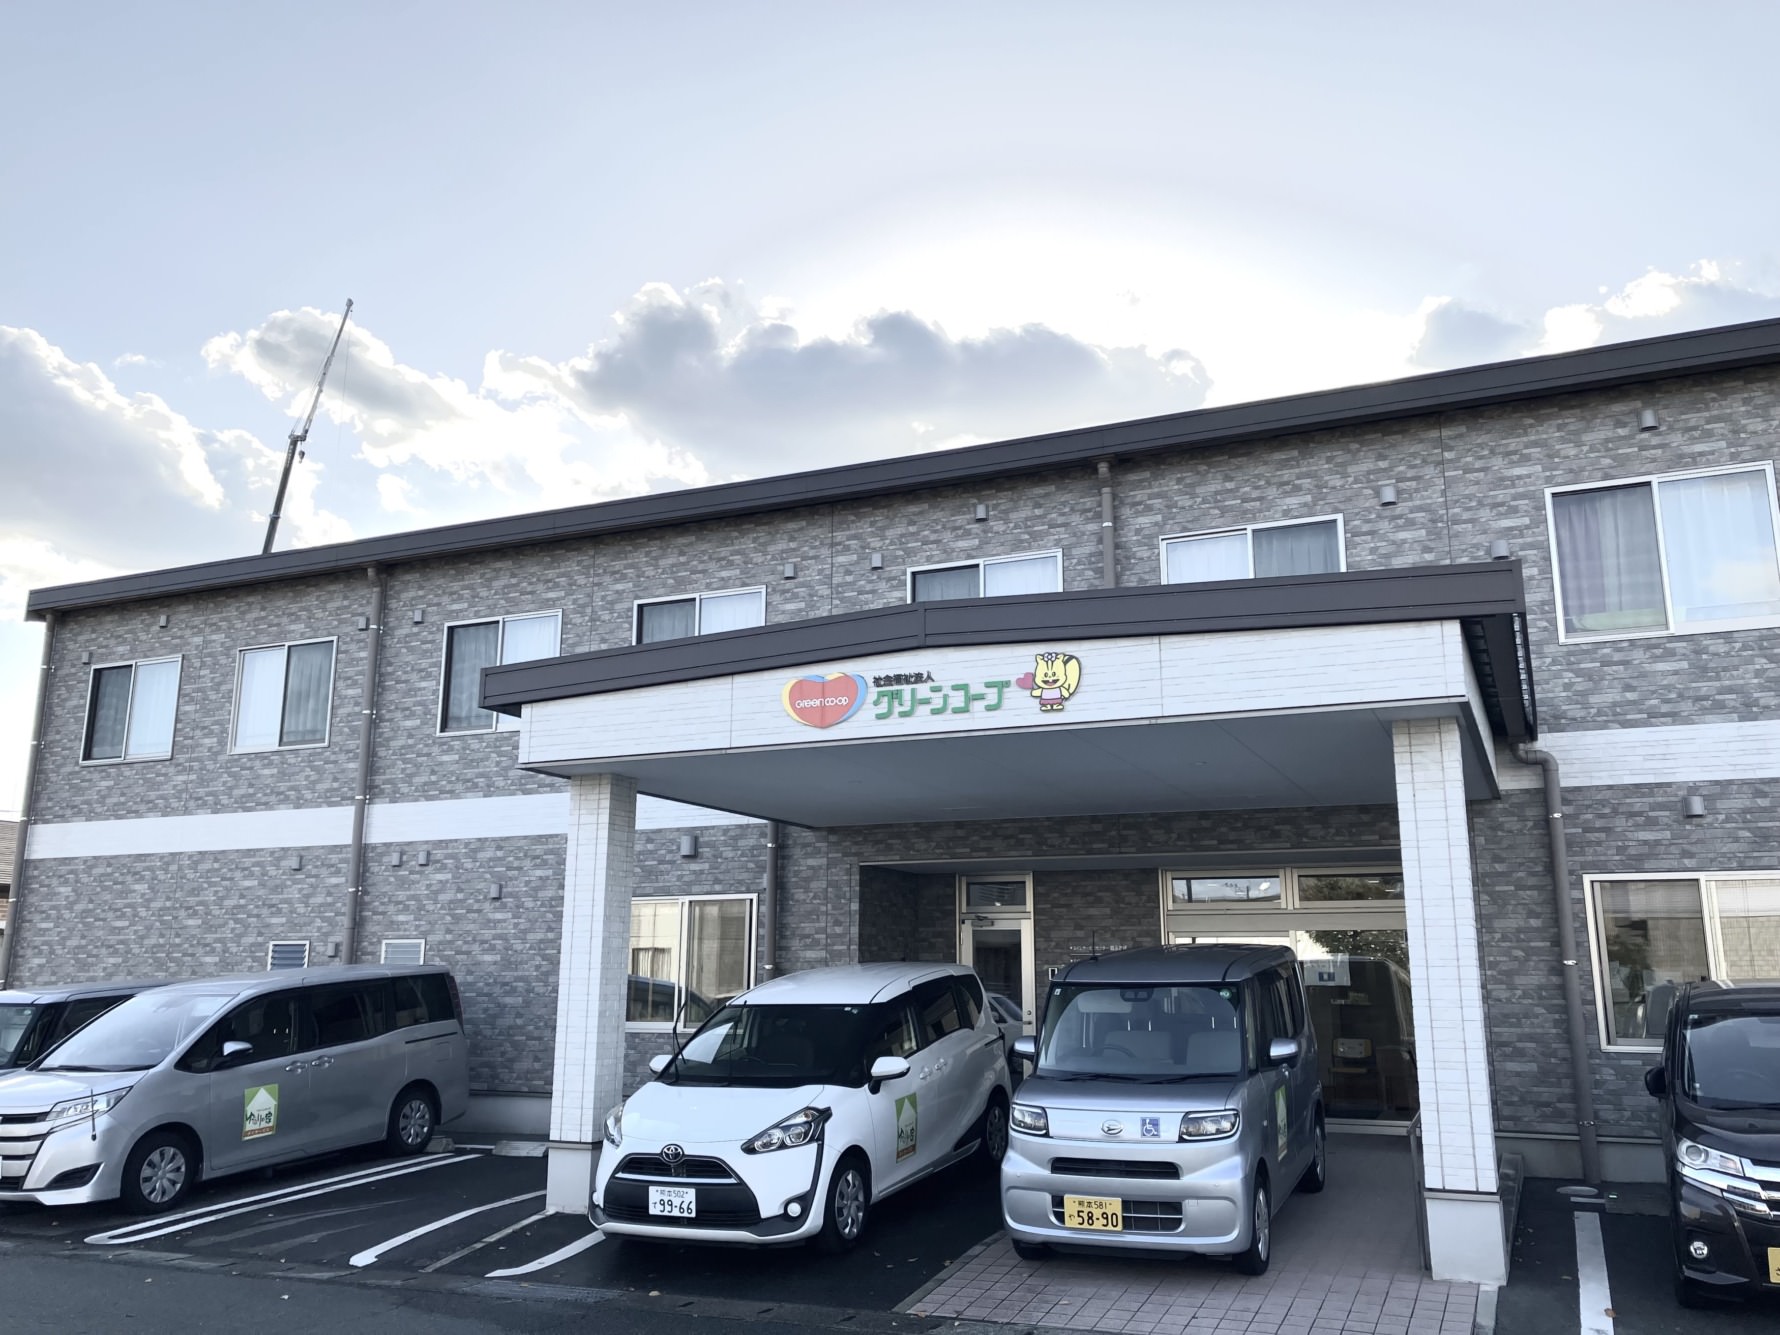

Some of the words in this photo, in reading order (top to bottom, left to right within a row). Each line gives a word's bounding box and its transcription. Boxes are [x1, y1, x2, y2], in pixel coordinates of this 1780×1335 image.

[872, 680, 1011, 720] グリーンコープ
[659, 1198, 693, 1215] 99-66
[1077, 1210, 1118, 1228] 58-90
